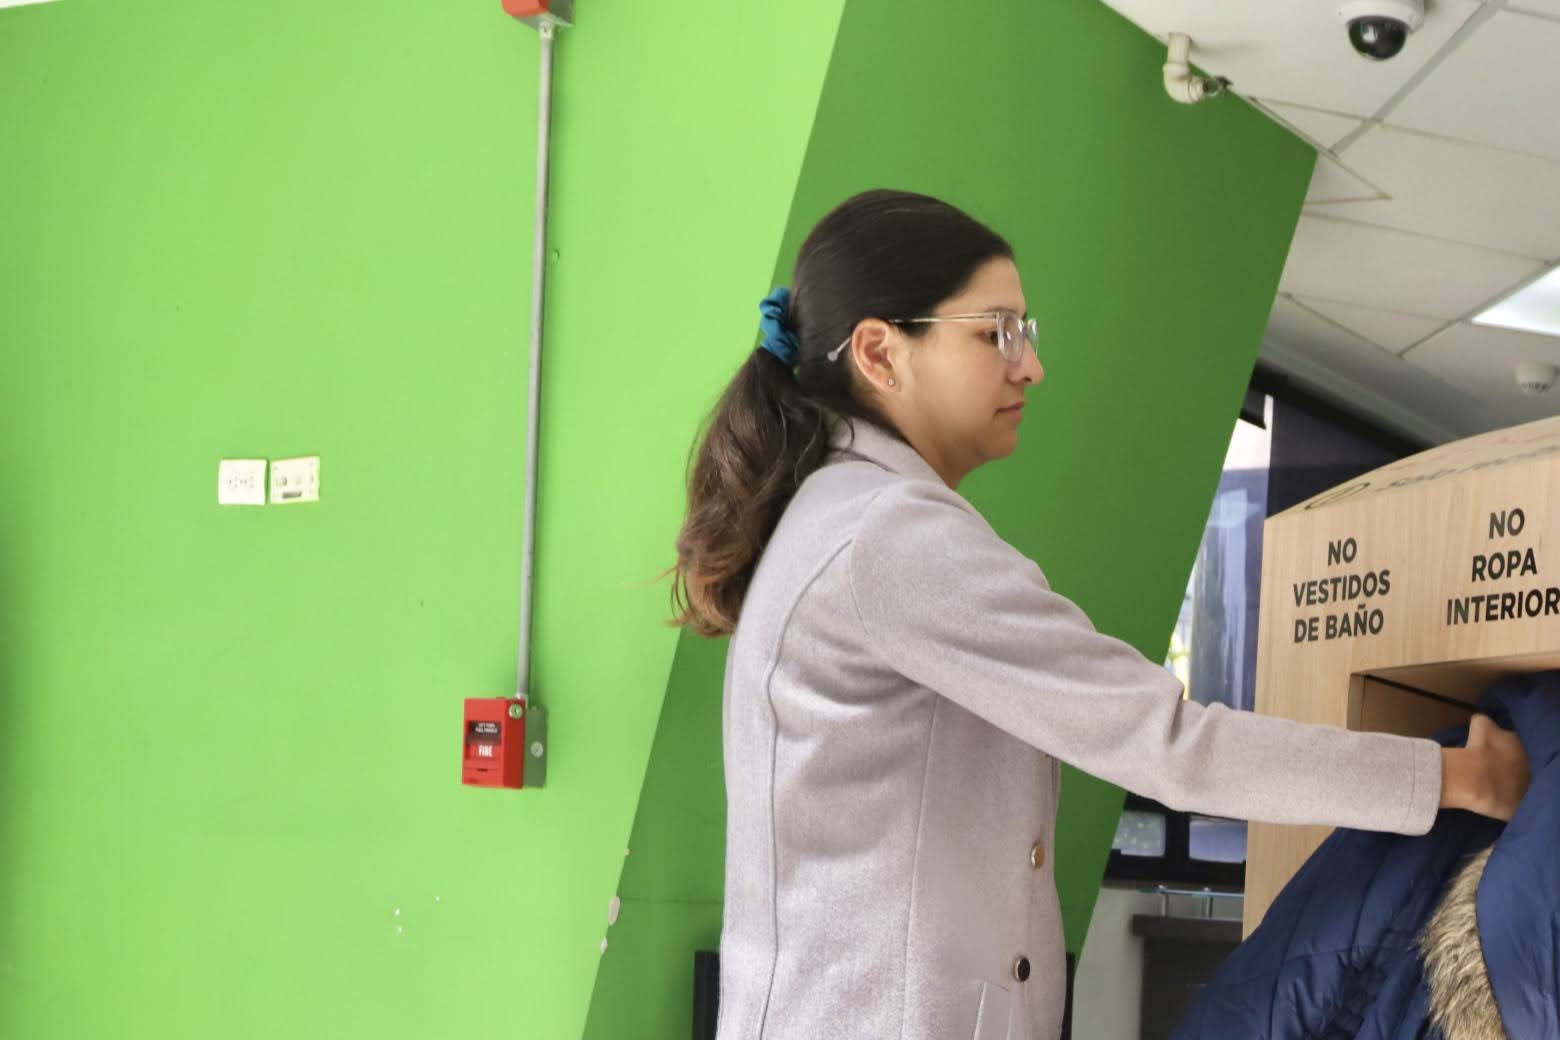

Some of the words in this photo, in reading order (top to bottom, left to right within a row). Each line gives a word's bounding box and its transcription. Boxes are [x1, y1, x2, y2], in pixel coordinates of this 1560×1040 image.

[1489, 508, 1525, 539] NO
[1327, 537, 1358, 566] NO
[1471, 547, 1538, 583] ROPA
[1293, 569, 1391, 607] VESTIDOS
[1446, 587, 1560, 626] INTERIOR
[1294, 617, 1319, 643] DE
[1325, 604, 1385, 640] BAÑO
